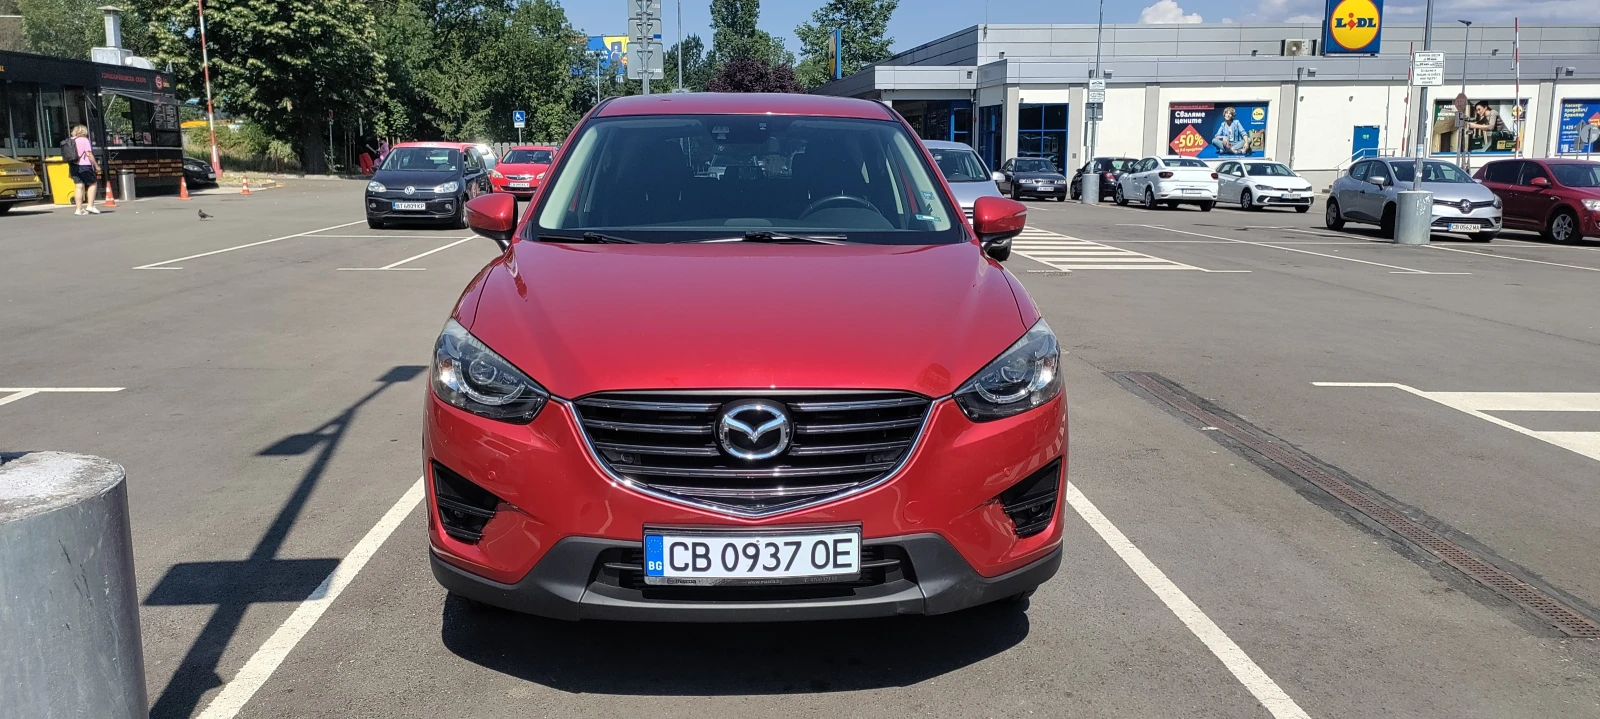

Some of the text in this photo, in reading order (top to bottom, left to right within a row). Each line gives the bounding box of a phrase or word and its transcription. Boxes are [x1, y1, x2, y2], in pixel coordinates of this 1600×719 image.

[1175, 134, 1204, 147] -50%
[669, 541, 712, 573] CB
[721, 541, 802, 573] 0937
[648, 561, 663, 571] BG
